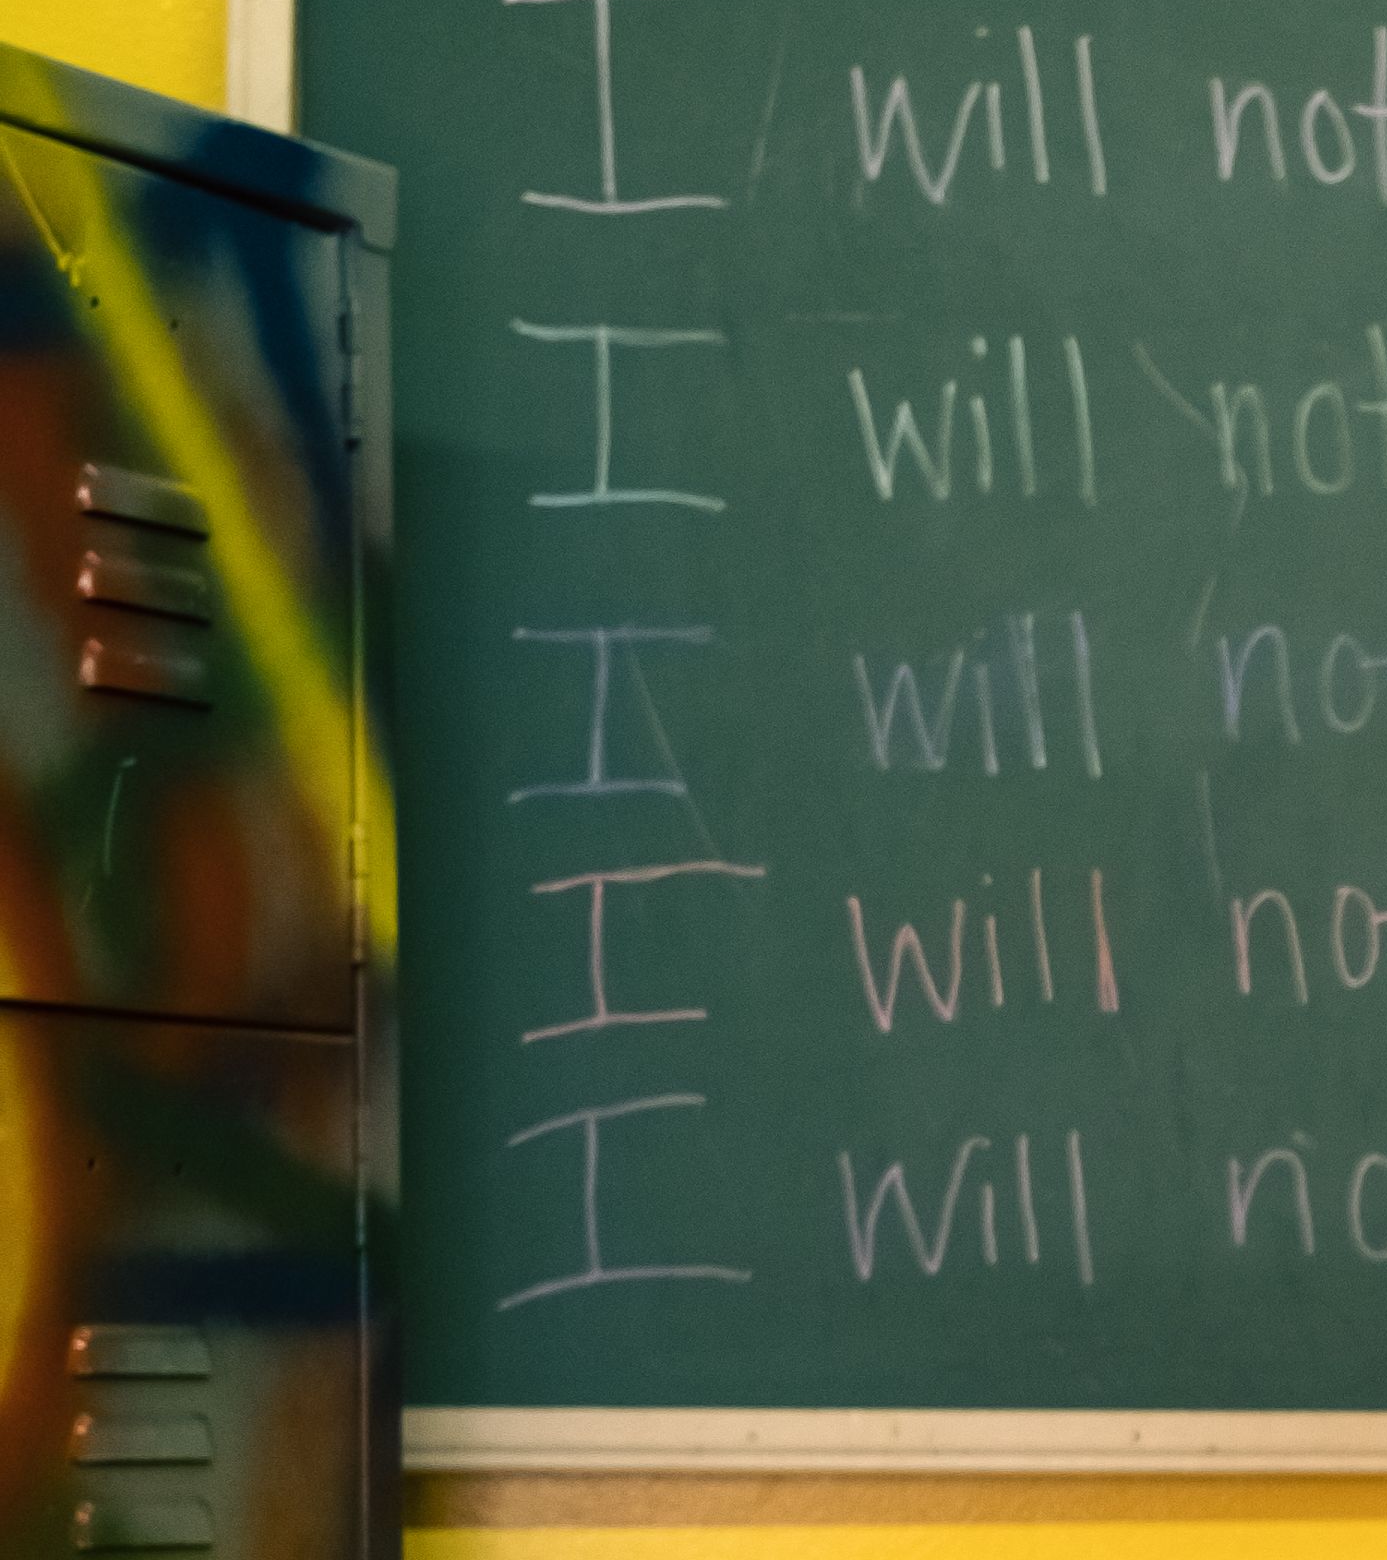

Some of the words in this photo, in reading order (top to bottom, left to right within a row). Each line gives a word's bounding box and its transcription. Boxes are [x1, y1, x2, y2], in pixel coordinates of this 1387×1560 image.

[850, 23, 1109, 204] will
[509, 318, 727, 512] I
[849, 334, 1097, 508] will
[509, 621, 717, 802] I
[849, 606, 1104, 780] will
[522, 858, 771, 1046] I
[844, 862, 1122, 1032] will
[496, 1091, 756, 1313] I
[836, 1126, 1096, 1288] will
